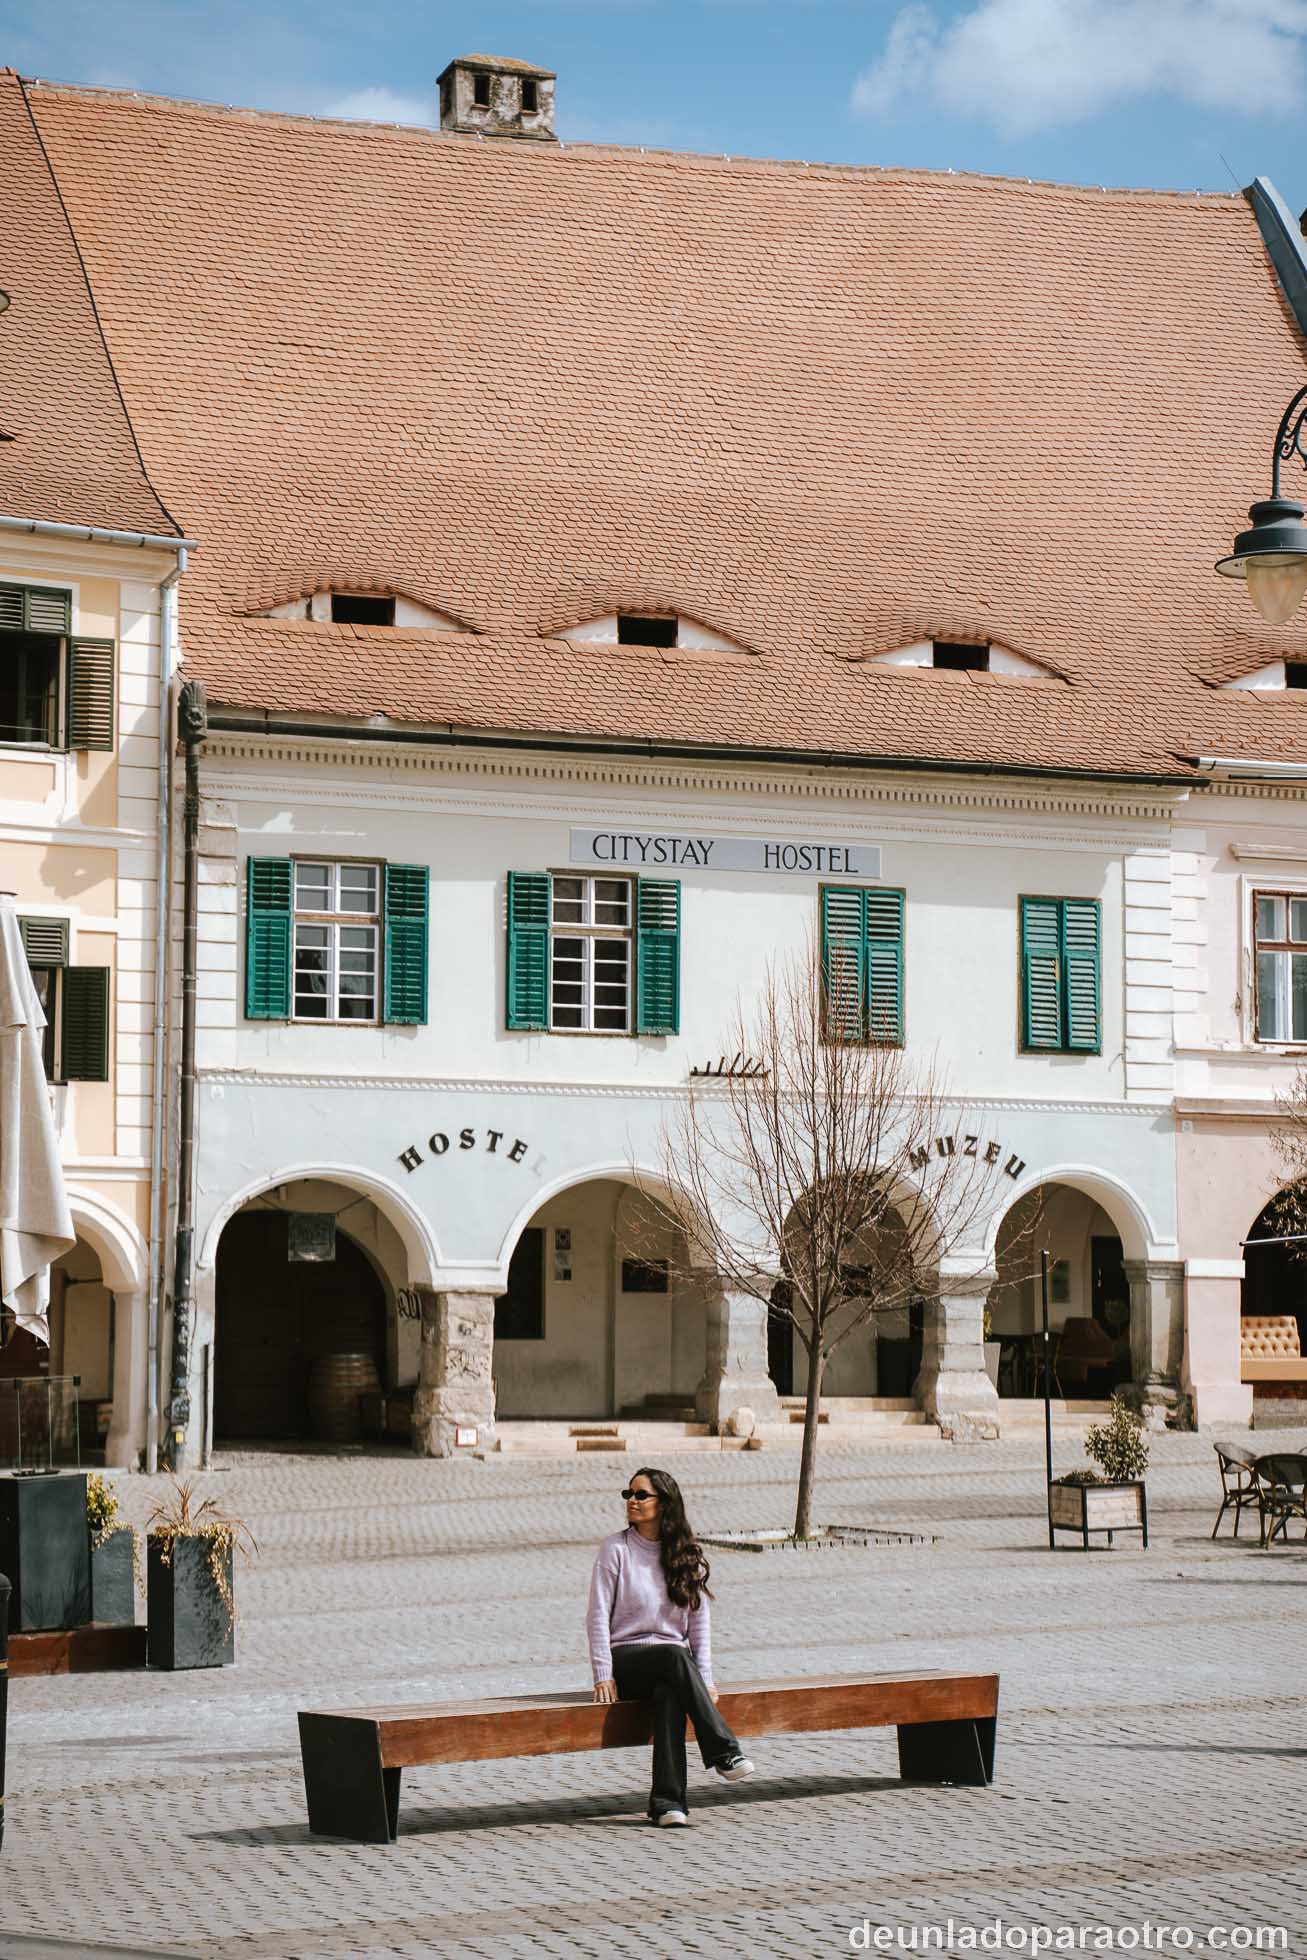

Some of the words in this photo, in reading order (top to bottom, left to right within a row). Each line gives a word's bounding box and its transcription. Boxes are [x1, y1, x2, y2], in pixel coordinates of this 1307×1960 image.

[593, 834, 714, 865] CITYSTAY
[764, 844, 858, 873] HOSTEL
[909, 1134, 1026, 1180] MUZEU
